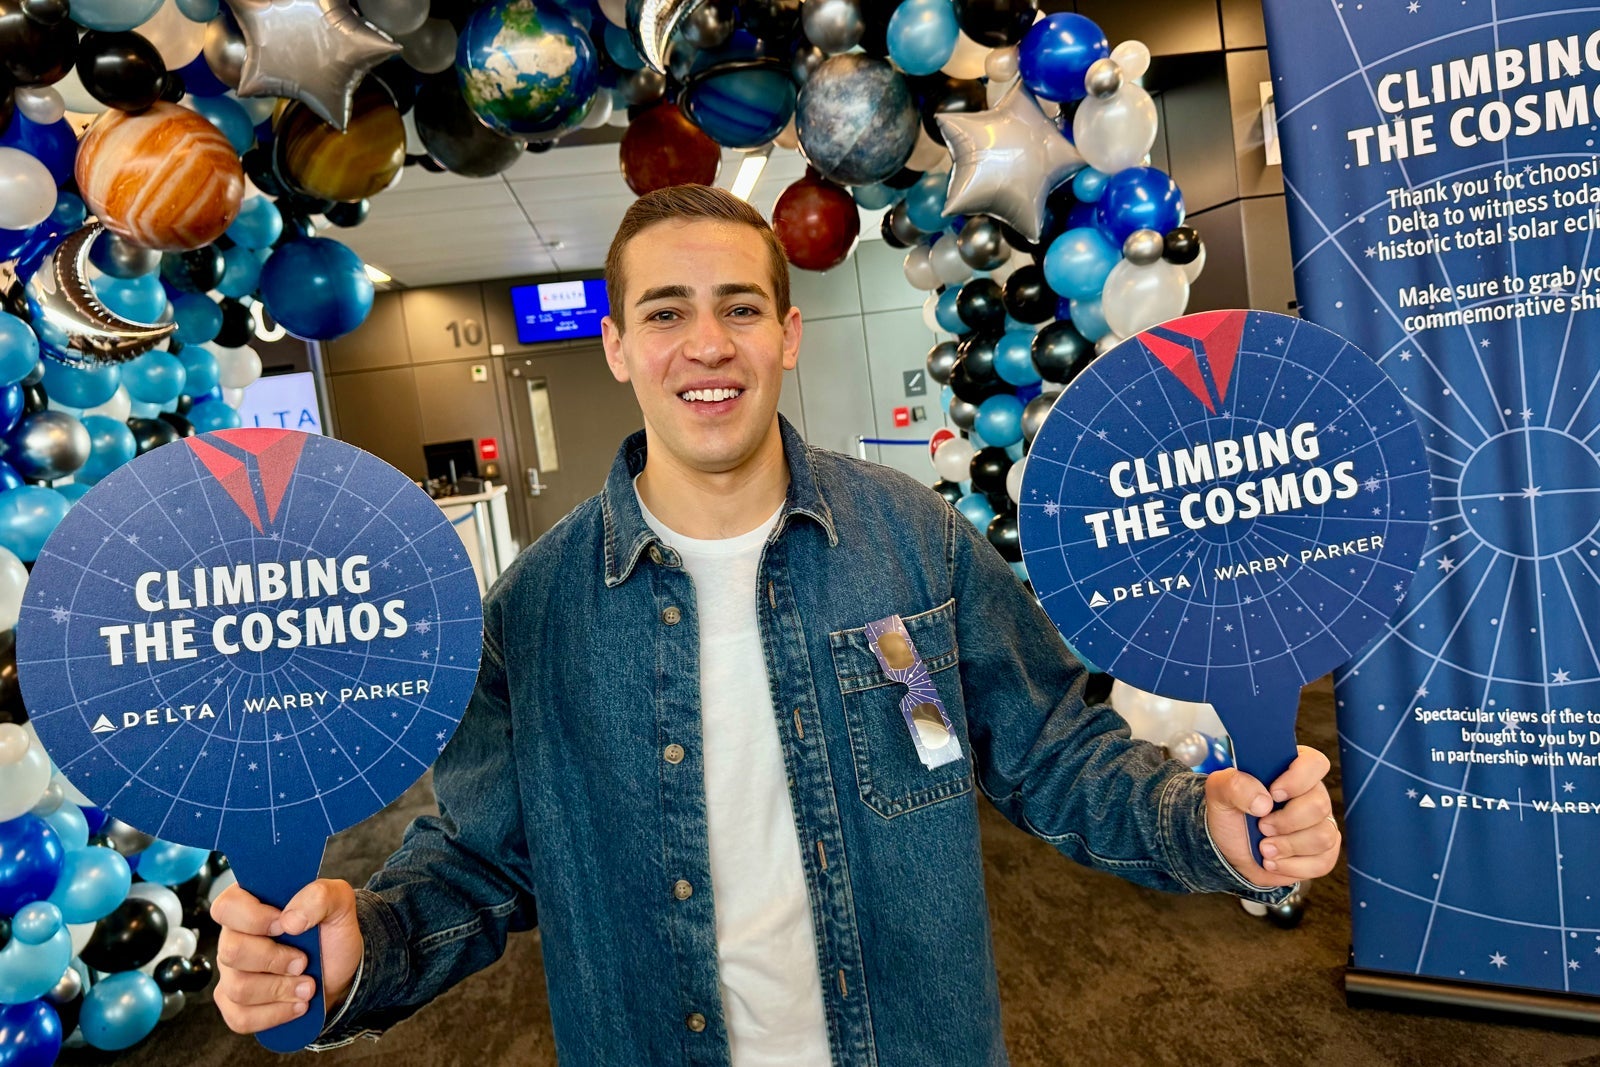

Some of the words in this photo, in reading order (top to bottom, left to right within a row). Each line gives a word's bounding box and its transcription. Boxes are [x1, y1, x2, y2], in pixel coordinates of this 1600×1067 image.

[1347, 115, 1437, 166] THE
[1450, 83, 1600, 147] COSM
[1387, 181, 1447, 209] Thank
[1452, 179, 1489, 201] you
[1494, 170, 1523, 192] for
[1388, 209, 1440, 235] Delta
[1443, 206, 1466, 227] to
[1469, 195, 1548, 221] witness
[1377, 233, 1452, 261] historic
[1455, 222, 1502, 250] total
[1508, 217, 1558, 242] solar
[1399, 284, 1452, 307] Make
[1456, 280, 1499, 300] sure
[1503, 275, 1525, 294] to
[1529, 264, 1576, 295] grab
[446, 319, 482, 347] 10
[1404, 295, 1566, 332] commemorative
[1108, 422, 1320, 499] CLIMBING
[1084, 500, 1170, 549] THE
[1180, 461, 1359, 530] COSMOS
[135, 555, 371, 612] CLIMBING
[1113, 574, 1191, 602] DELTA
[1214, 554, 1290, 581] WARBY
[1301, 535, 1384, 563] PARKER
[100, 619, 198, 666] THE
[212, 600, 408, 655] COSMOS
[123, 703, 216, 728] DELTA
[244, 691, 328, 713] WARBY
[340, 679, 430, 702] PARKER
[1415, 707, 1494, 724] Spectacular
[1498, 708, 1538, 723] views
[1541, 709, 1556, 724] of
[1559, 709, 1583, 724] the
[1431, 748, 1445, 762] in
[1447, 748, 1528, 766] partnership
[1531, 751, 1564, 766] with
[1567, 751, 1600, 766] War
[1462, 728, 1517, 747] brought
[1520, 729, 1535, 744] to
[1538, 733, 1565, 748] you
[1568, 730, 1586, 748] by
[1441, 795, 1510, 811] DELTA
[1532, 799, 1600, 814] WARBY
